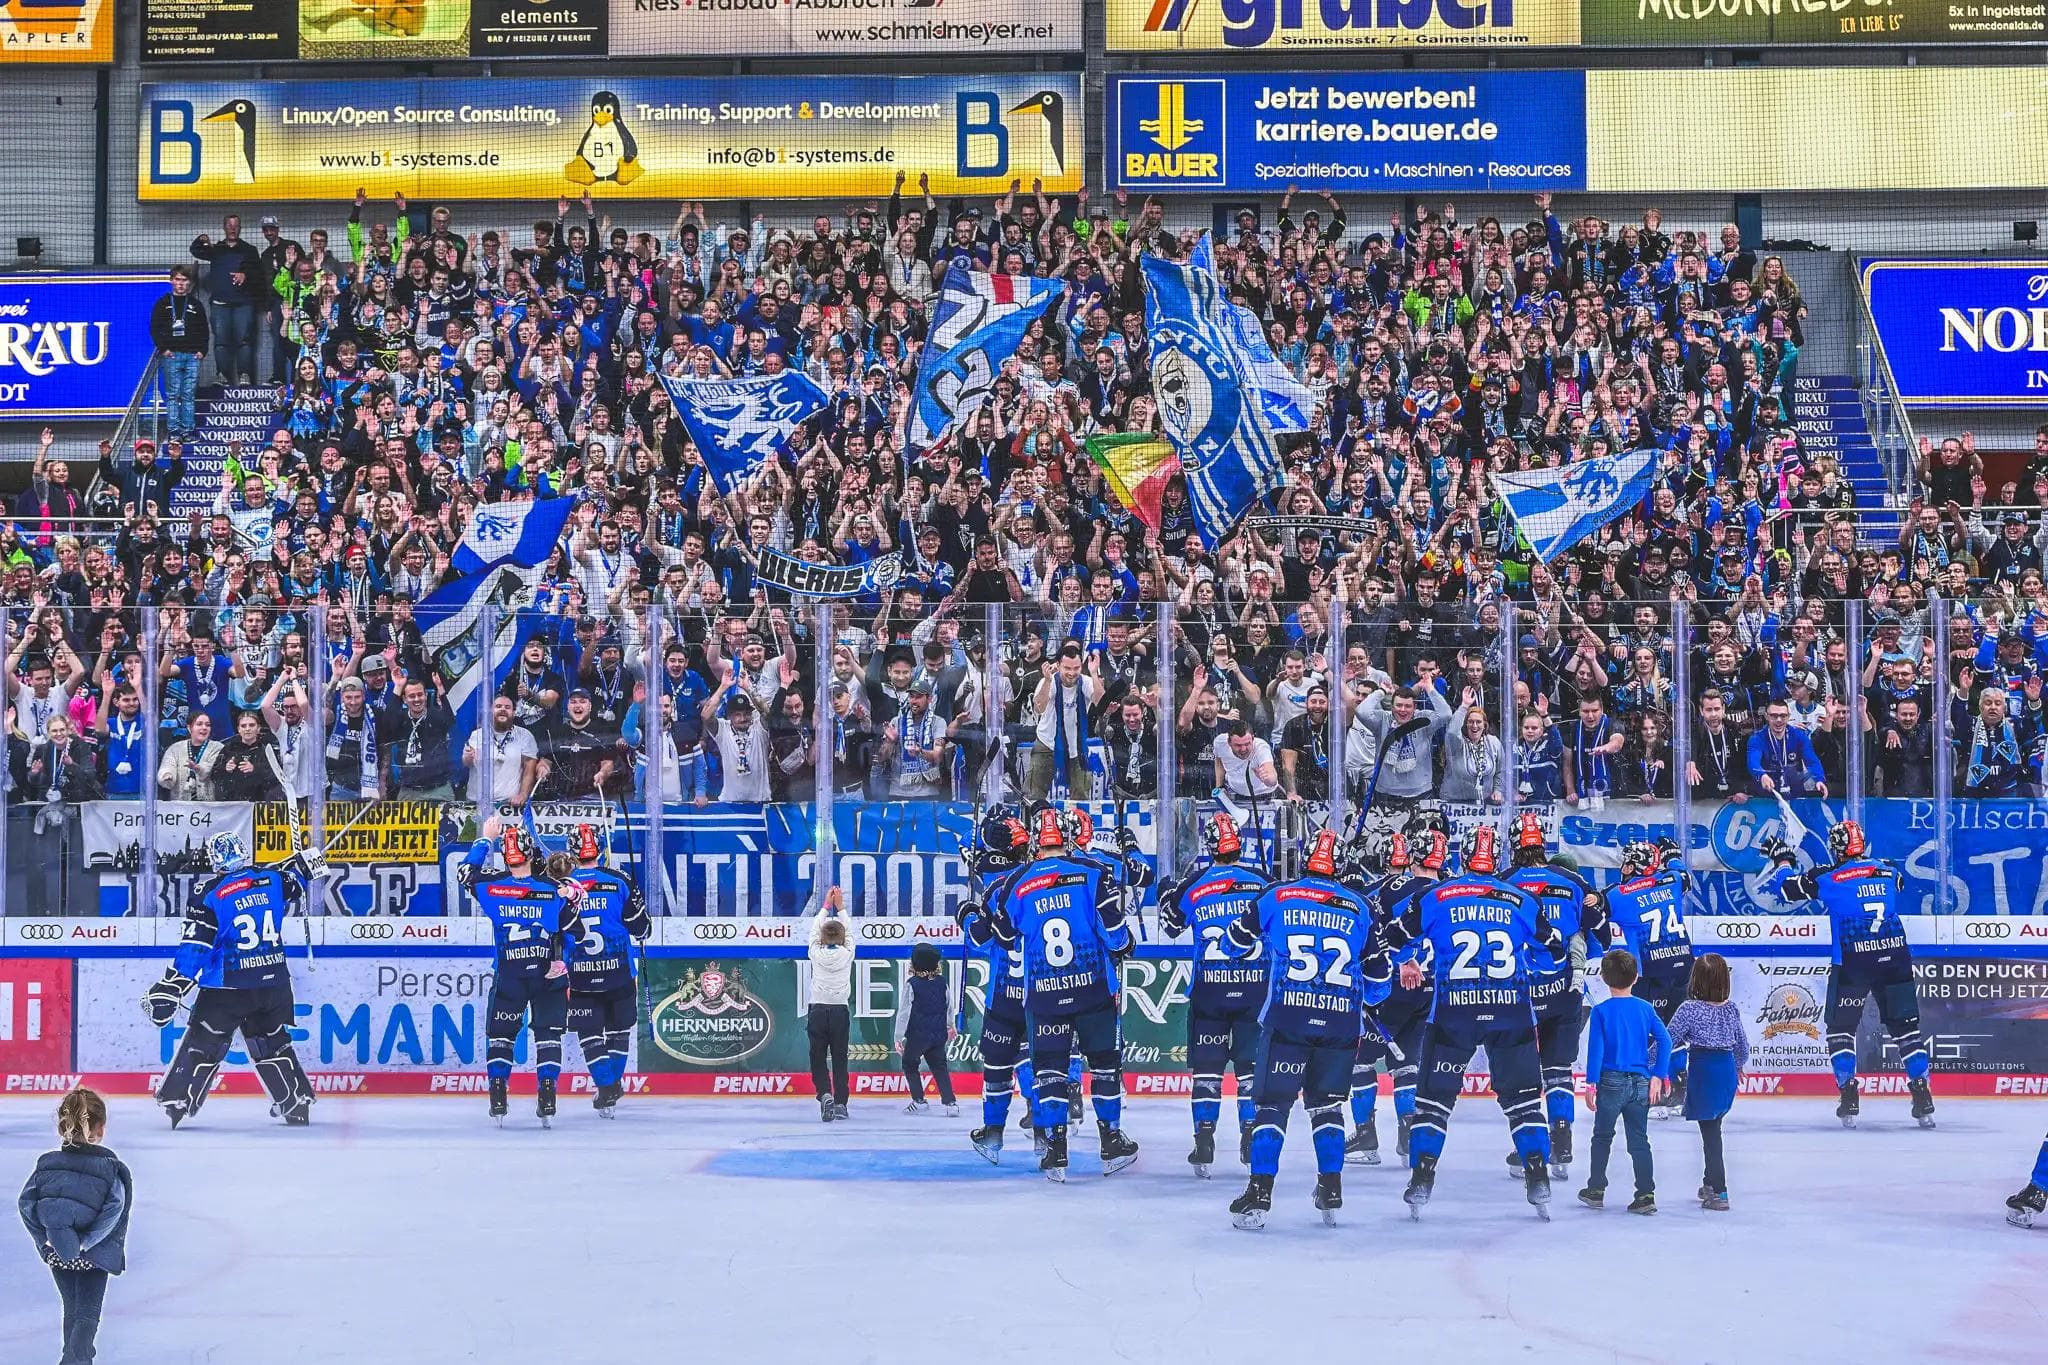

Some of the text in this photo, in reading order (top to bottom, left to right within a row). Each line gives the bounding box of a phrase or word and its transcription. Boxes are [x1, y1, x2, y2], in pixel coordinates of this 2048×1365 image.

[500, 9, 578, 24] elements
[1948, 5, 1964, 17] 5x
[1982, 4, 2046, 19] Ingolstadt
[815, 20, 1054, 45] www.schmidmeyer.net
[1840, 17, 1856, 34] ICH
[1860, 16, 1886, 33] LIEBE
[1948, 20, 2045, 32] www.mcdonalds.de
[487, 35, 504, 43] BAD
[557, 34, 592, 42] ENERGIE
[1281, 32, 1530, 45] Siemensstr. 7 Gaimersheim
[1254, 85, 1476, 110] Jetzt bewerben!
[282, 105, 562, 129] Linux/Open Source Consulting,
[637, 101, 941, 124] Training, Support & Development
[1255, 118, 1498, 142] karriere.bauer.de
[319, 151, 500, 170] www.b1-systems.de
[707, 147, 895, 168] info@b1-systems.de
[1126, 153, 1219, 177] BAUER
[1254, 161, 1571, 181] Spezialtiefbau Maschinen Resources
[223, 388, 279, 400] NORDBRÄ
[206, 415, 272, 428] NORDBRÄU
[199, 430, 266, 443] NORDBRÄU
[189, 811, 213, 828] 64
[257, 826, 287, 851] FÜR
[381, 829, 430, 850] JETZT
[1724, 809, 1783, 852] 64
[1856, 883, 1887, 899] JOBKE
[234, 892, 270, 911] GARTEIG
[499, 905, 543, 919] SIMPSON
[1450, 906, 1512, 925] EDWARDS
[1863, 902, 1886, 934] 7
[232, 909, 279, 950] 34
[745, 924, 791, 938] Audi
[913, 924, 960, 938] Audi
[1283, 909, 1355, 935] HENRIQUEZ
[1640, 904, 1686, 944] 74
[1769, 923, 1816, 938] Audi
[71, 925, 117, 939] Audi
[401, 925, 448, 938] Audi
[1042, 918, 1074, 967] 8
[1650, 942, 1690, 961] INGOLSTADT
[1854, 935, 1906, 954] INGOLSTADT
[240, 951, 286, 970] INGOLSTADT
[1286, 934, 1352, 987] 52
[1449, 930, 1517, 981] 23
[573, 958, 620, 972] INGOLSTADT
[1942, 964, 1980, 978] DEN
[1986, 964, 2037, 978] PUCK
[377, 965, 496, 997] Person
[1035, 971, 1094, 993] INGOLSTADT
[1204, 969, 1264, 983] INGOLSTADT
[1449, 988, 1518, 1006] INGOLSTADT
[1957, 984, 2001, 998] DICH
[1283, 991, 1351, 1013] INGOLSTADT
[1755, 1002, 1824, 1024] Fairplay
[661, 1018, 764, 1033] HERRNBRÄU
[1036, 1024, 1070, 1036] JOOP!
[983, 1028, 1012, 1045] JOOP!
[1761, 1045, 1830, 1055] FACHHÄNDLE
[1752, 1057, 1830, 1067] IN INGOLSTADT
[1927, 1062, 2025, 1070] OBILITY SOLUTIONS
